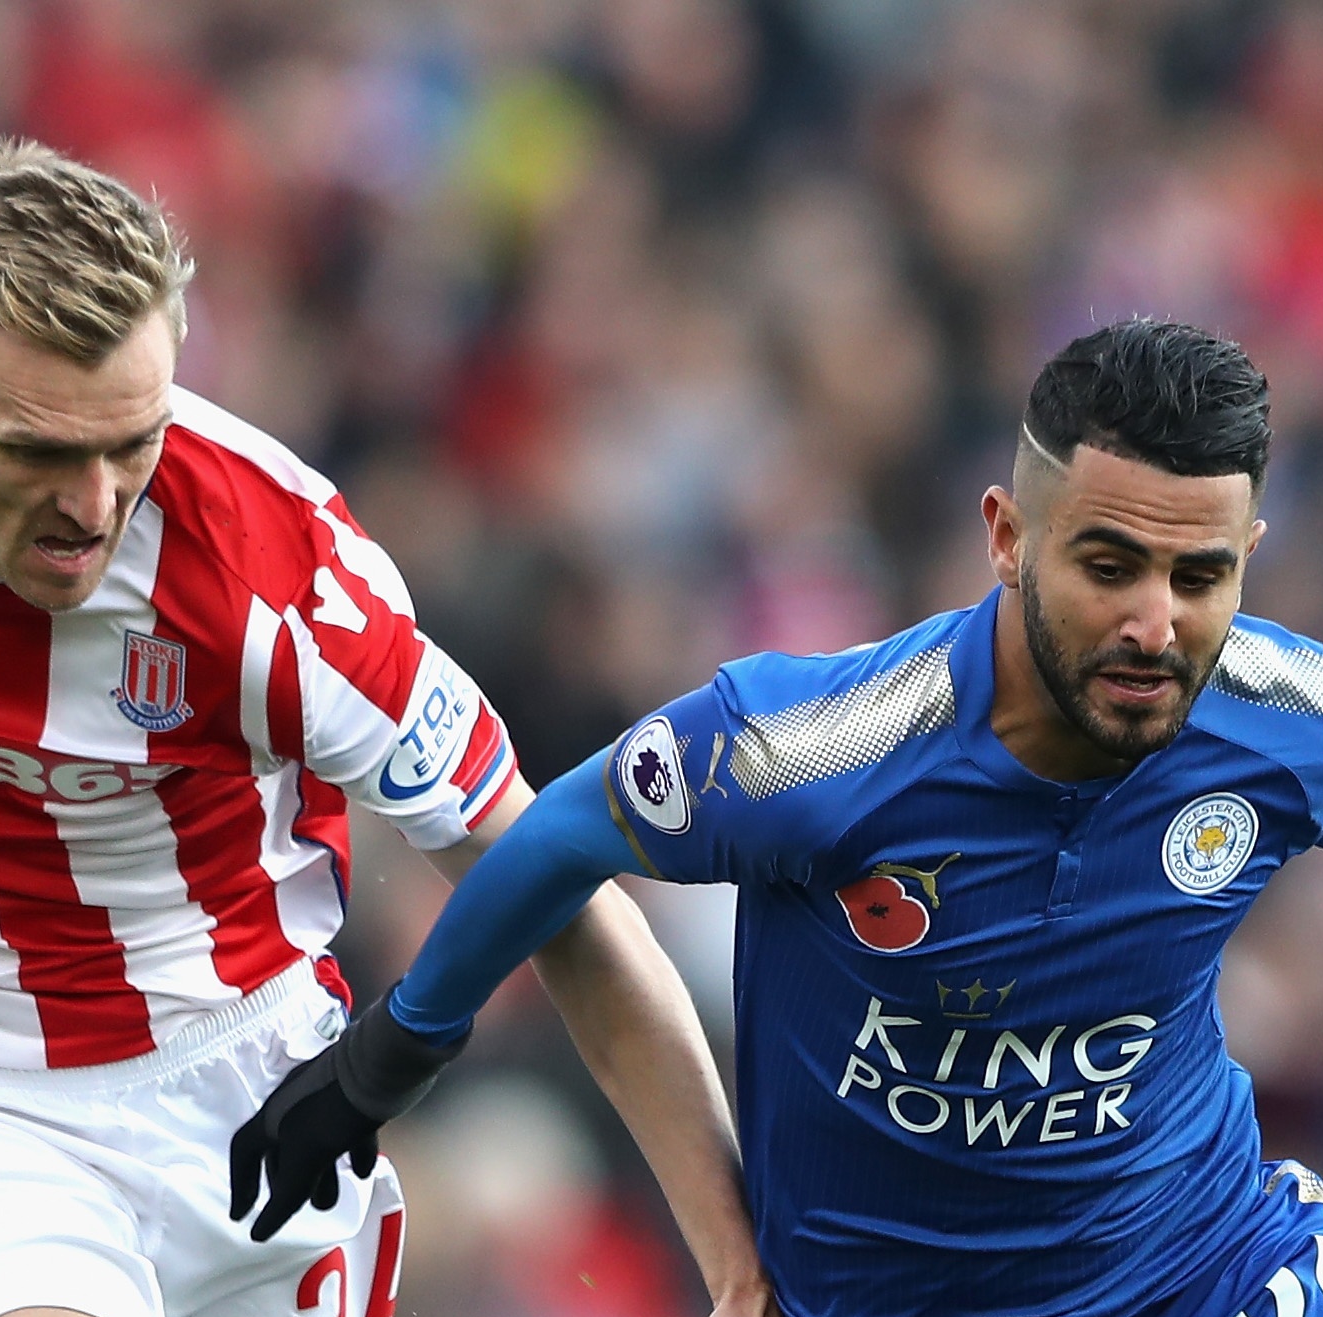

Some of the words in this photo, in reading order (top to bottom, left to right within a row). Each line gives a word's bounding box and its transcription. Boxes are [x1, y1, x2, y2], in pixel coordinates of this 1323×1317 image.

[1173, 803, 1234, 845] LEICESTER
[1233, 809, 1250, 834] CITY
[1171, 852, 1223, 885] FOOTBALL
[1222, 839, 1247, 872] CLUB
[854, 996, 1158, 1090] KING
[836, 1053, 1132, 1148] POWER
